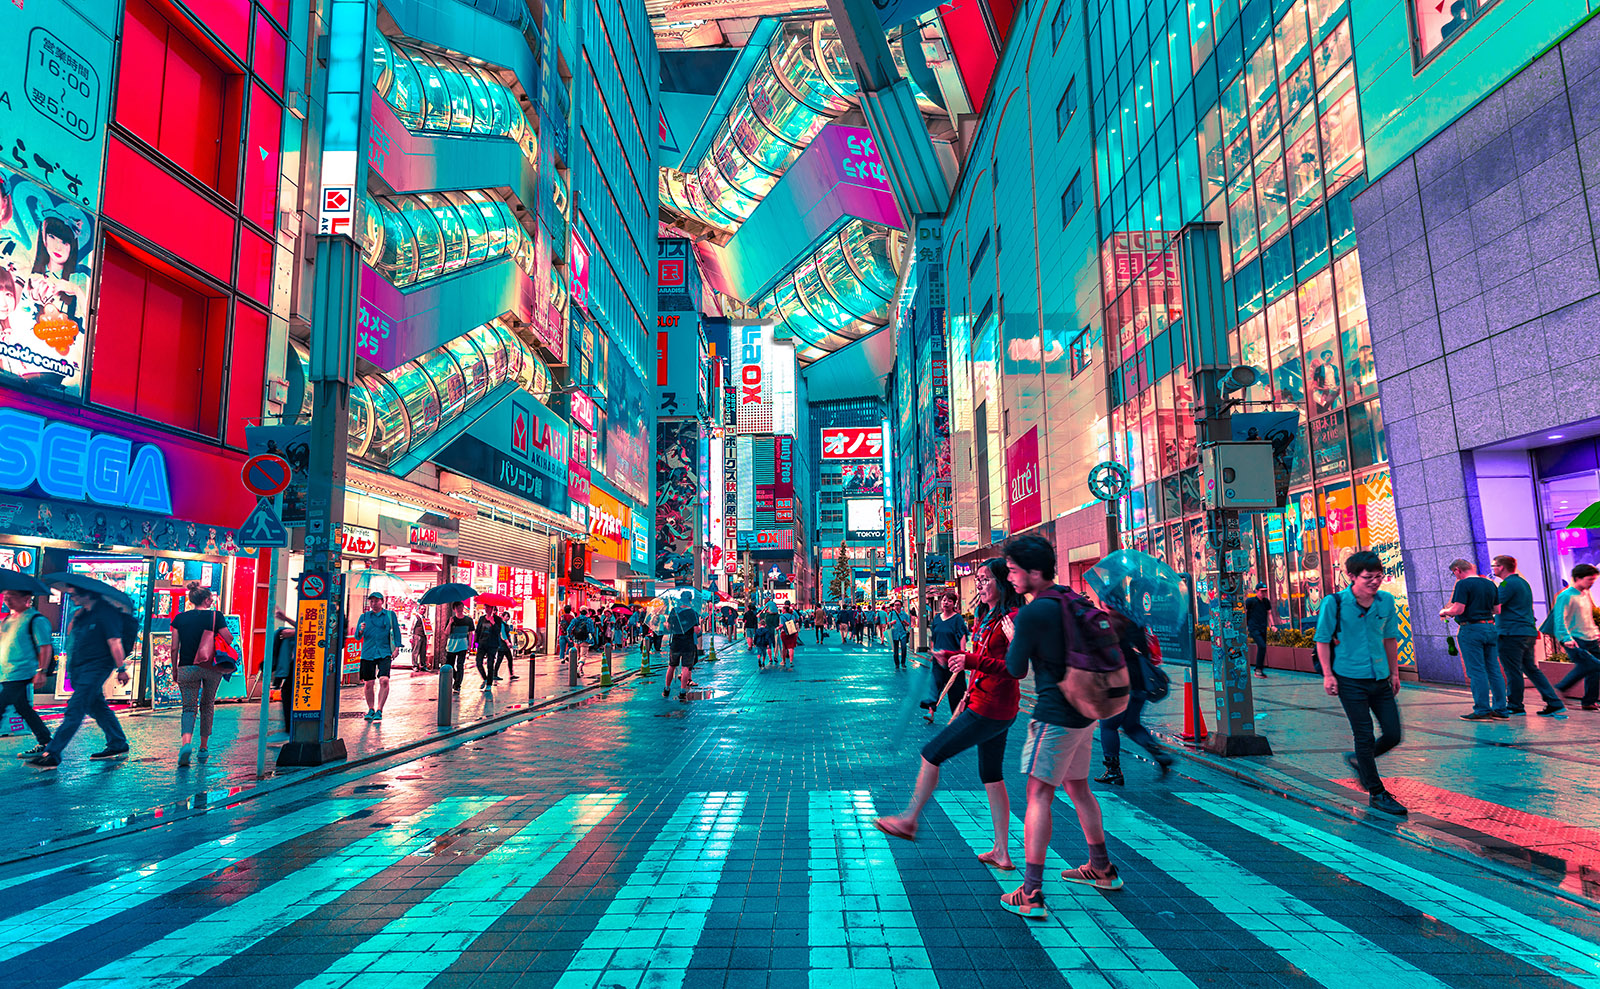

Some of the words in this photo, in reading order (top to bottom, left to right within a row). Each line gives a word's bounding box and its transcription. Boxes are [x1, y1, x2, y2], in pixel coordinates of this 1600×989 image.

[39, 51, 91, 99] 16:00
[43, 38, 90, 79] 営業時間
[32, 87, 90, 135] 翌5:00
[0, 138, 91, 207] らです。
[919, 228, 941, 240] DU
[358, 307, 390, 340] カメラ
[358, 332, 379, 355] メラ
[571, 391, 592, 426] アコム
[533, 414, 567, 466] LABI
[781, 438, 791, 460] Duty
[0, 407, 173, 515] SEGA
[531, 452, 567, 482] AKIHABARA
[781, 461, 791, 483] Free
[499, 459, 543, 500] パソコン館
[1011, 462, 1032, 502] atré
[1034, 462, 1039, 493] 1
[419, 527, 438, 543] LABI
[318, 603, 326, 637] 千代田区内は
[301, 608, 318, 707] 路上喫煙禁止です。
[347, 642, 362, 653] au
